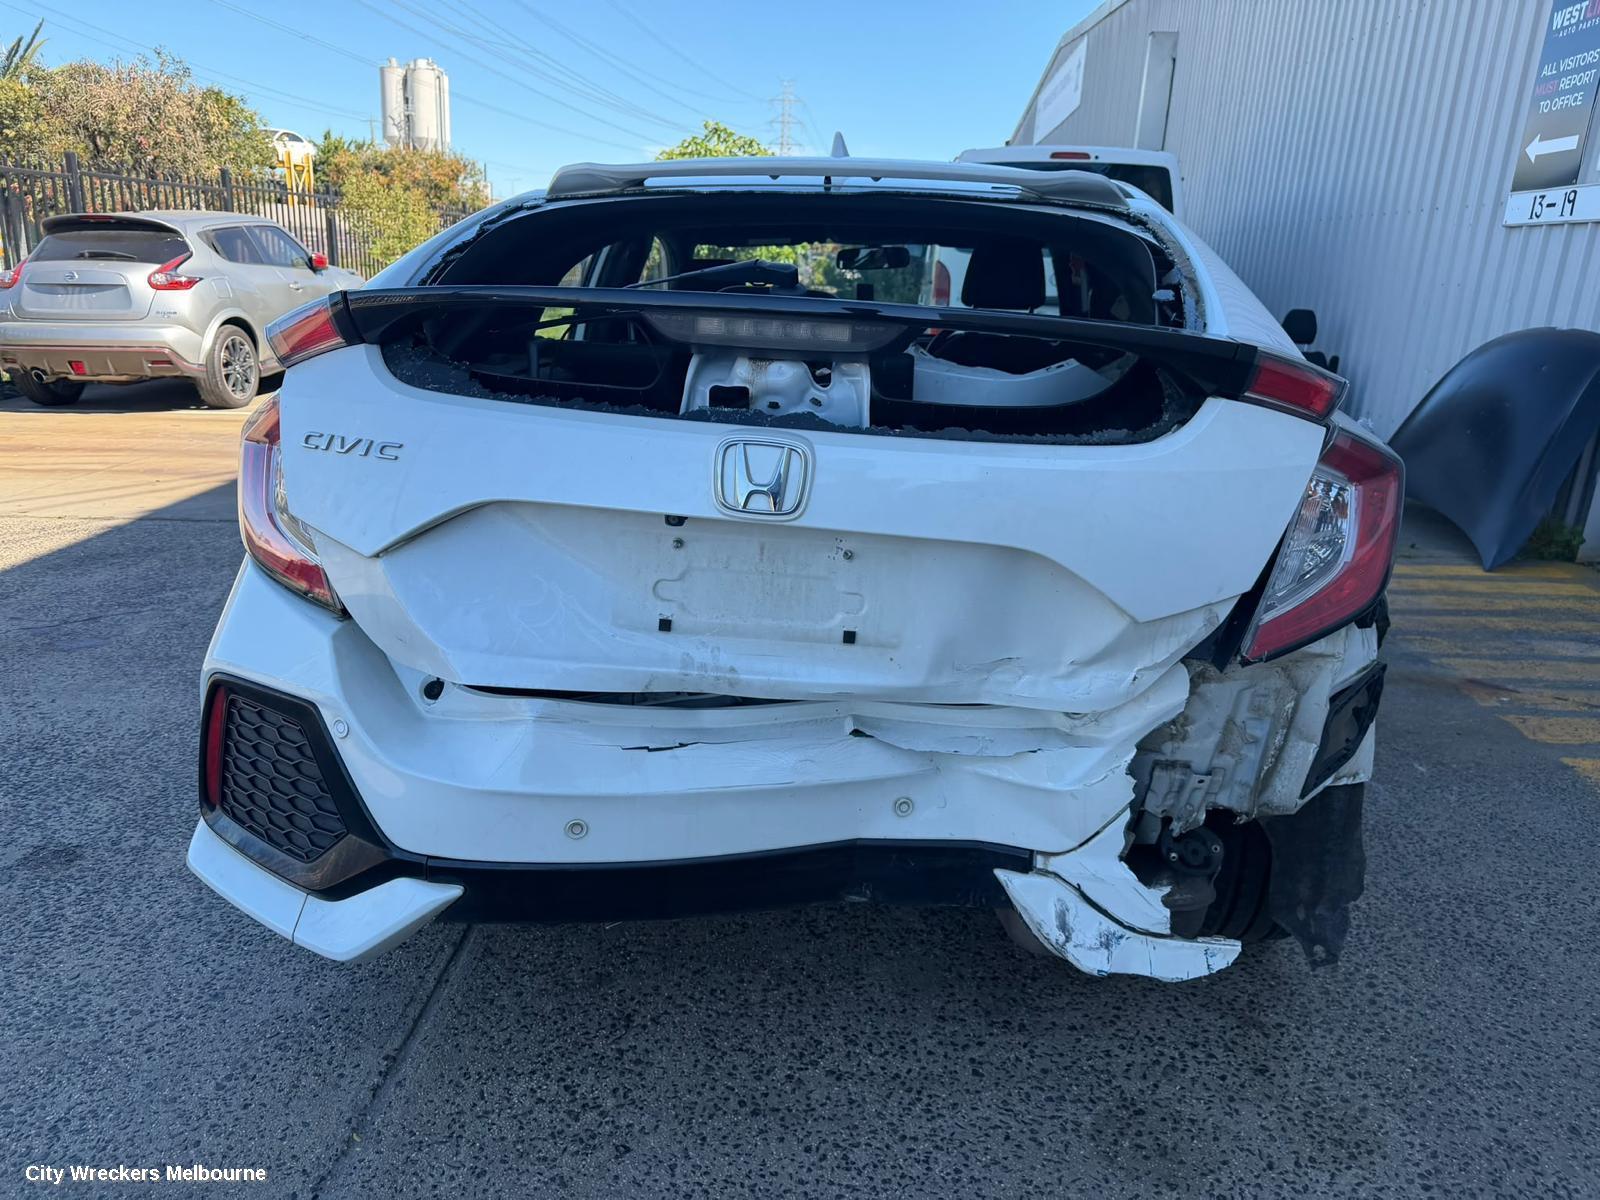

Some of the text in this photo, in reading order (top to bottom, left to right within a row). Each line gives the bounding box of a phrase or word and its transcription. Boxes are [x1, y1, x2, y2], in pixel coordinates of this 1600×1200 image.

[1559, 17, 1600, 37] AUTO PARTS
[1541, 49, 1600, 78] ALL VISITORS
[1536, 69, 1597, 96] MUST REPORT
[1539, 92, 1584, 113] TO OFFICE
[301, 431, 404, 460] CIVIC
